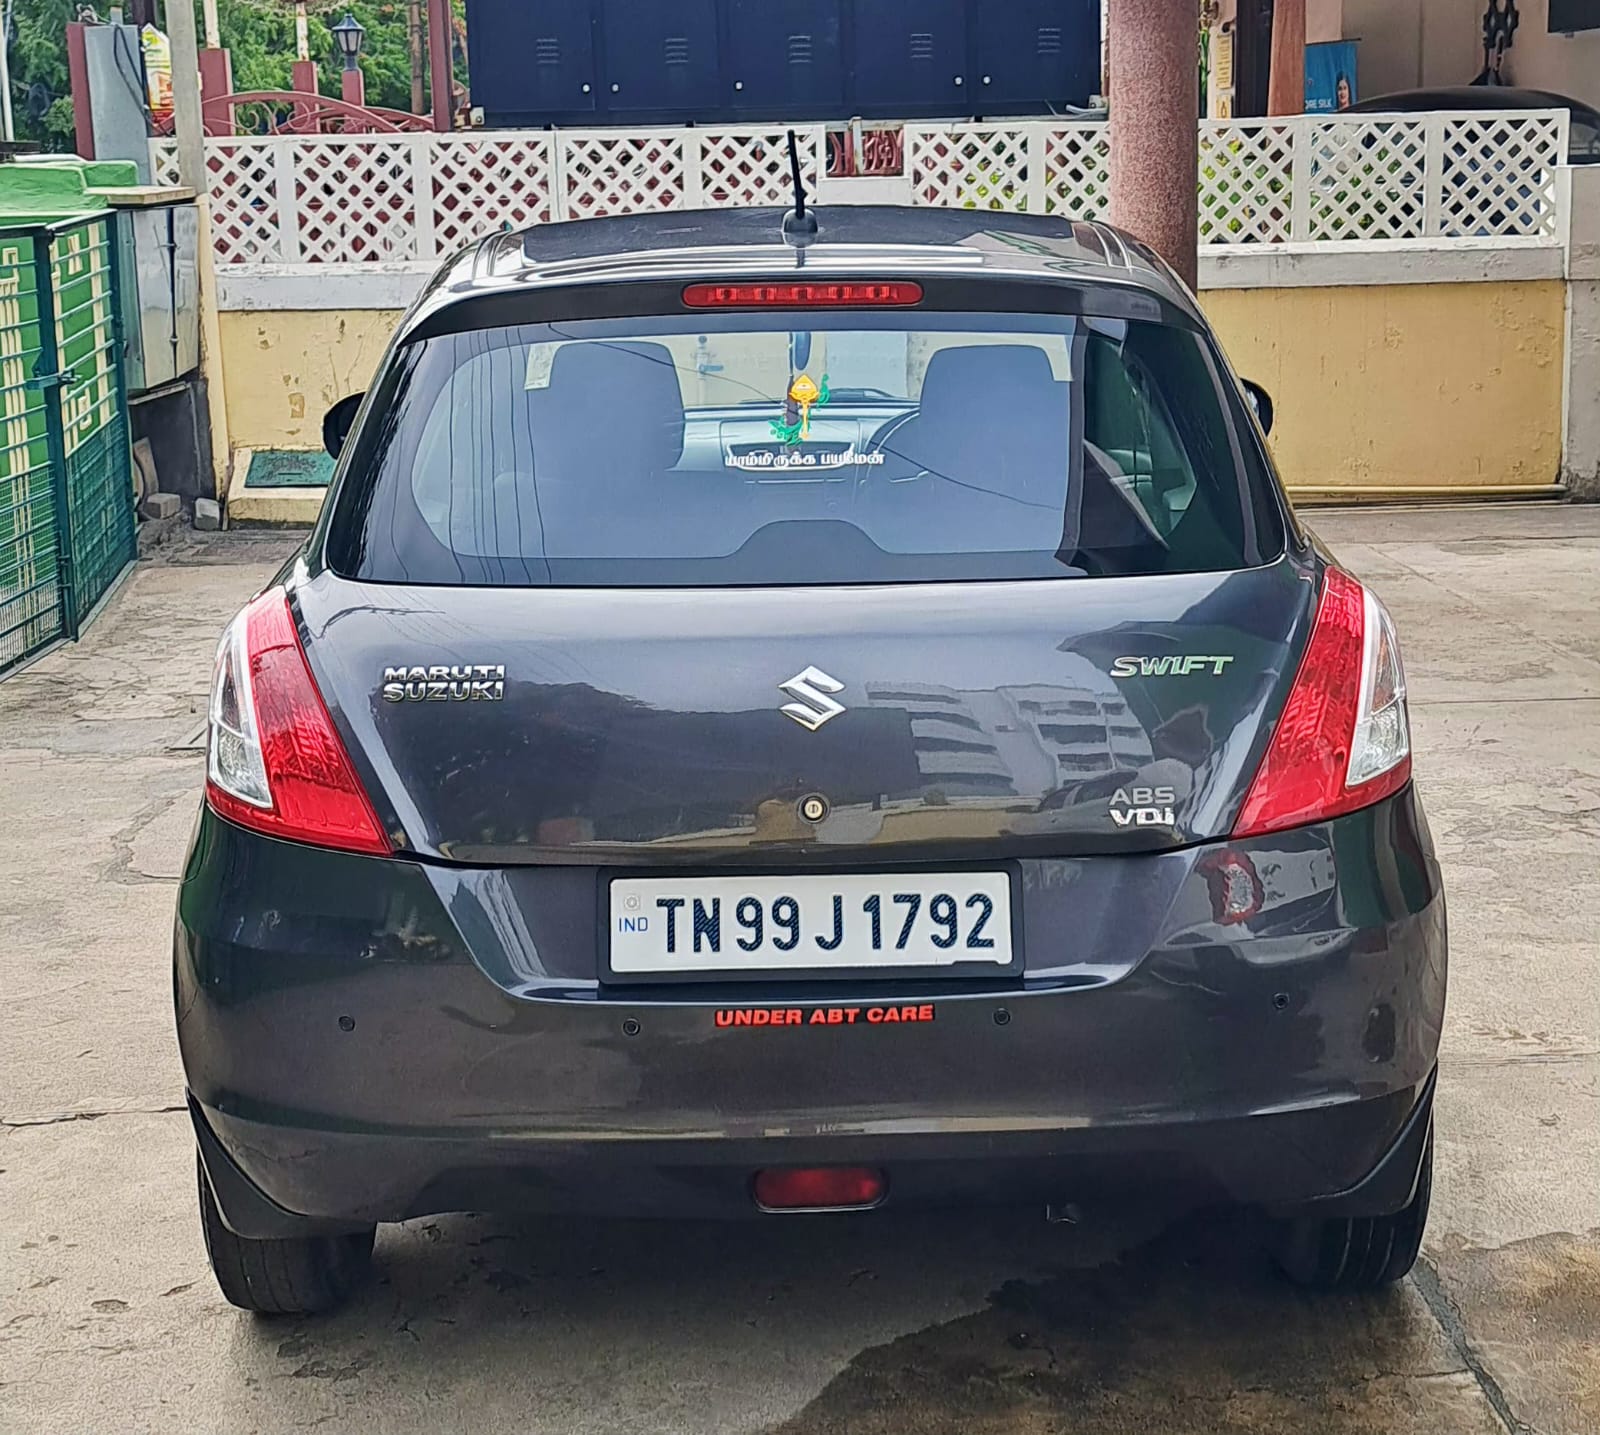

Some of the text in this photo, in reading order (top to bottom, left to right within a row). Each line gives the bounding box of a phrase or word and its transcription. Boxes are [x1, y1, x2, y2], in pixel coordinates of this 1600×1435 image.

[383, 664, 506, 681] MARUTI
[1110, 656, 1234, 676] SWIFT
[383, 681, 505, 702] SUZUKI
[1109, 786, 1176, 806] ABS
[1109, 807, 1175, 827] VDi
[618, 917, 648, 932] IND
[656, 897, 721, 953] TN
[735, 896, 800, 952] 99
[863, 893, 995, 950] 1792
[715, 1005, 934, 1027] UNDER ABT CARE
